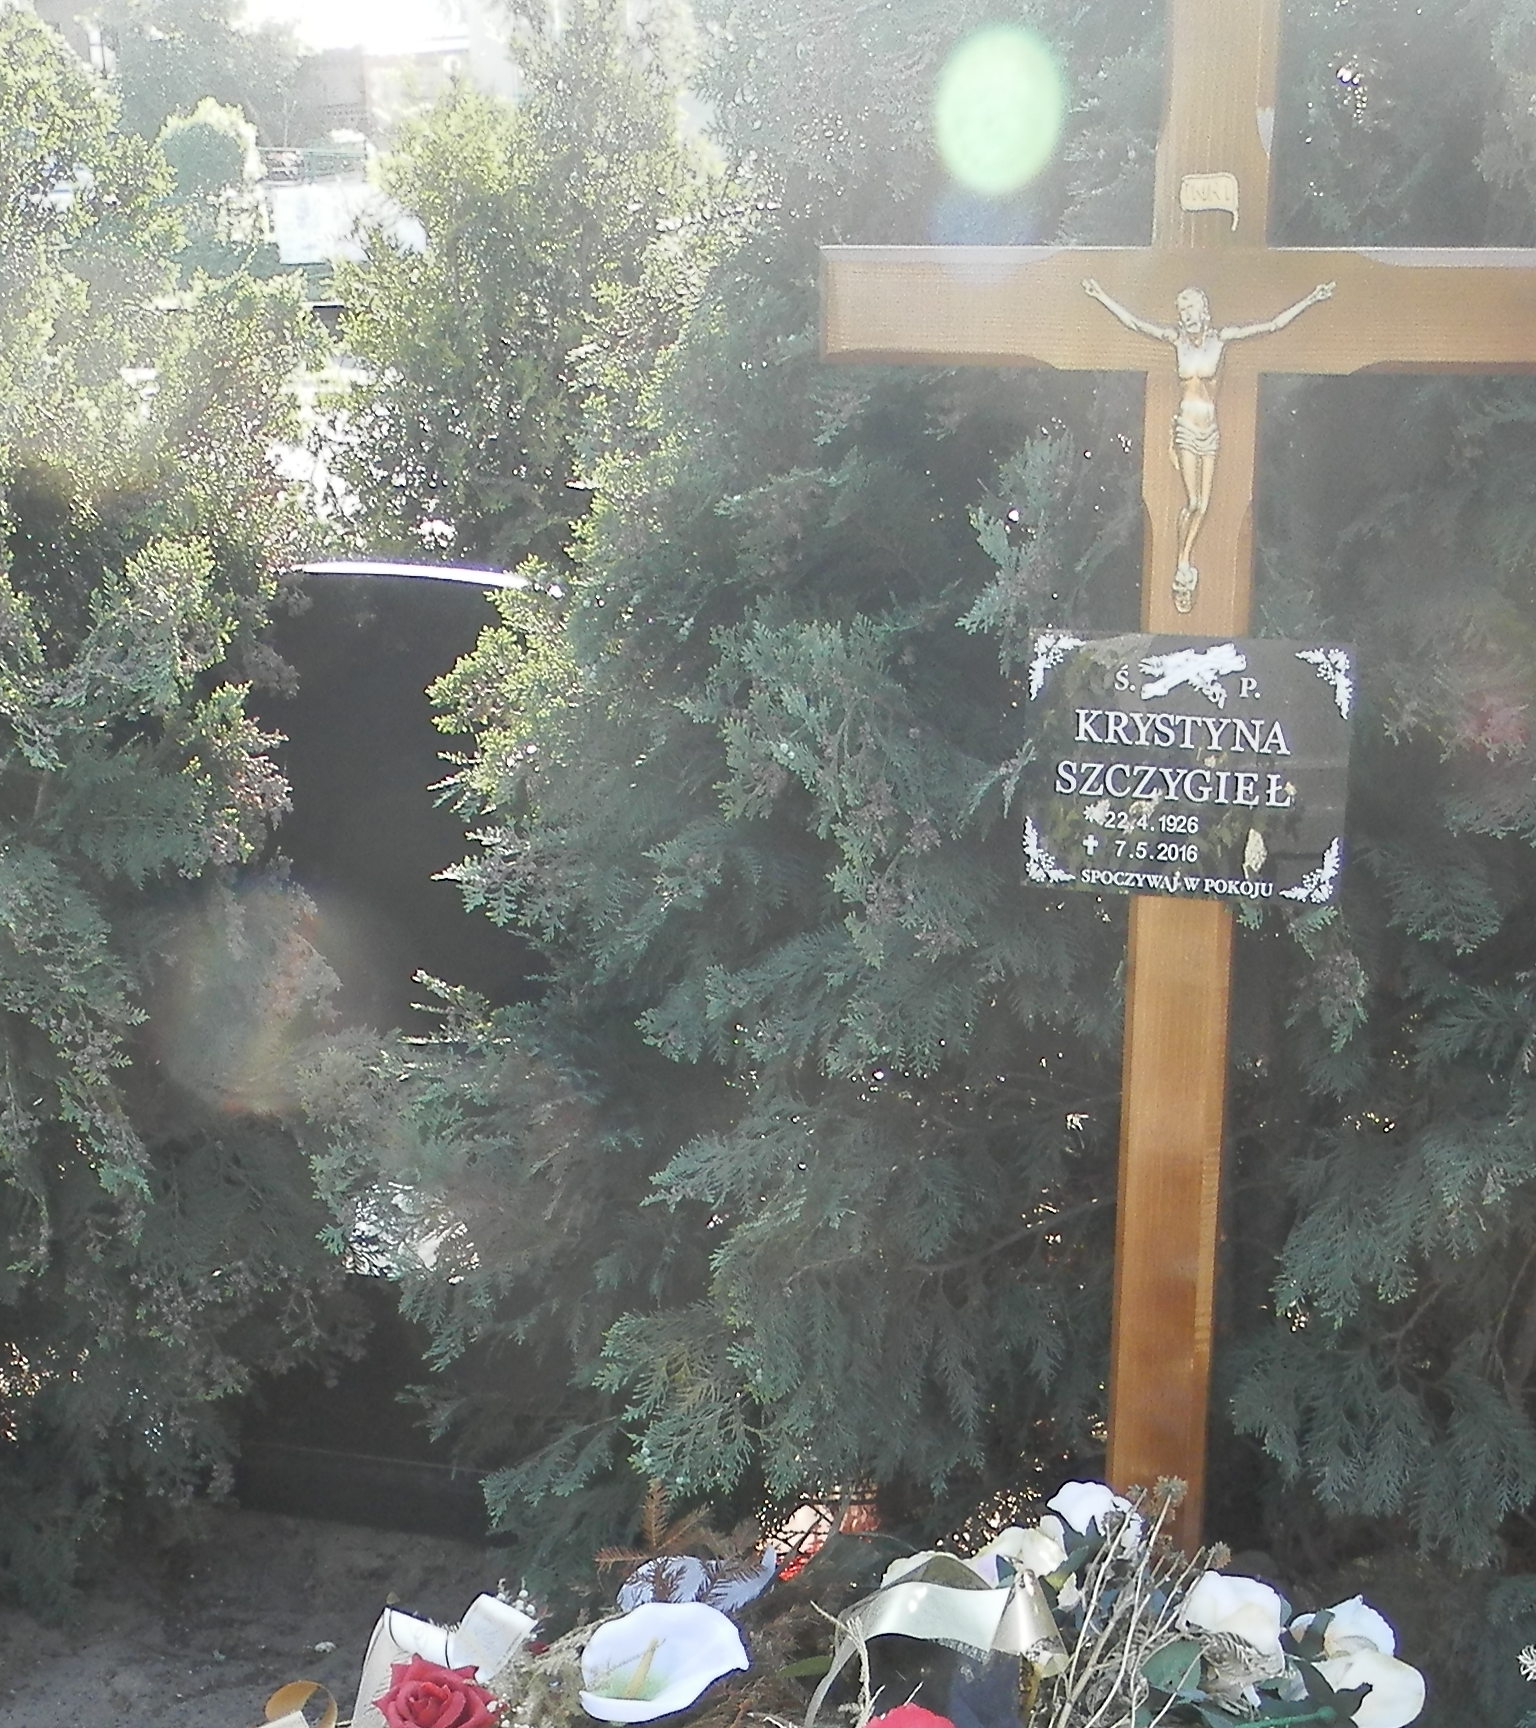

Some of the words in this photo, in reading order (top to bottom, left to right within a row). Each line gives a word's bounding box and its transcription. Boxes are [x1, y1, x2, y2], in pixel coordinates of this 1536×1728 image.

[1240, 677, 1261, 699] P.
[1074, 709, 1291, 756] KRYSTYNA
[1055, 760, 1292, 808] SZCZYGIEŁ
[1114, 838, 1199, 863] 7.5.2016
[1080, 868, 1182, 893] SPOCZYWAJ
[1183, 876, 1201, 892] W
[1203, 880, 1274, 899] POKOJU
